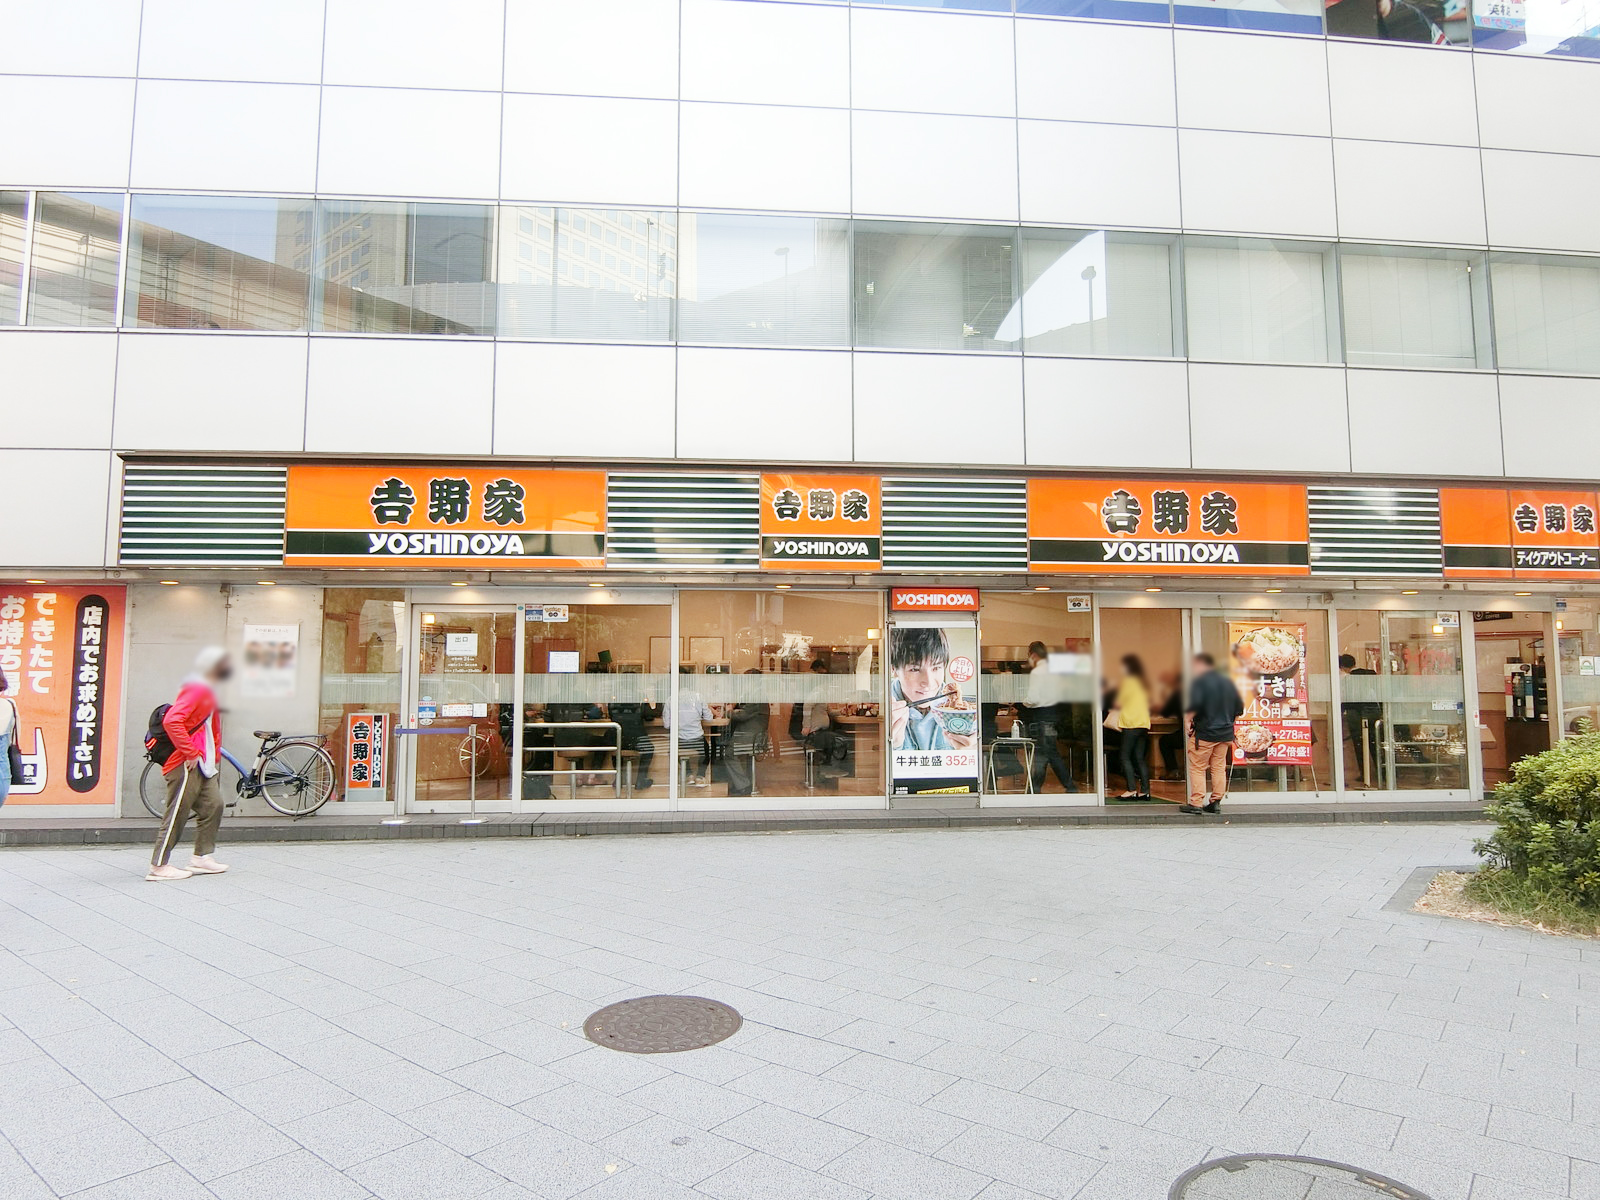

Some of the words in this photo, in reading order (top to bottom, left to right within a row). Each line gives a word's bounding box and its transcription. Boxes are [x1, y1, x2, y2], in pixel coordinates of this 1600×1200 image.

[370, 477, 526, 527] 吉野家
[772, 488, 870, 522] 吉野家
[1101, 489, 1239, 536] 吉野家
[1514, 502, 1595, 534] 吉野家
[368, 533, 525, 555] YOSHINOYA
[773, 541, 869, 555] YOSHINOYA
[1102, 542, 1240, 563] YOSHINOYA
[1516, 551, 1596, 566] テイクアウトコーナー
[896, 594, 975, 606] YOSHINOYA
[28, 592, 57, 694] できたて
[72, 605, 103, 781] 店内でお求め下さい
[351, 721, 371, 782] 吉野家
[373, 721, 382, 781] YOSHINOYA
[896, 755, 943, 767] 牛丼並盛
